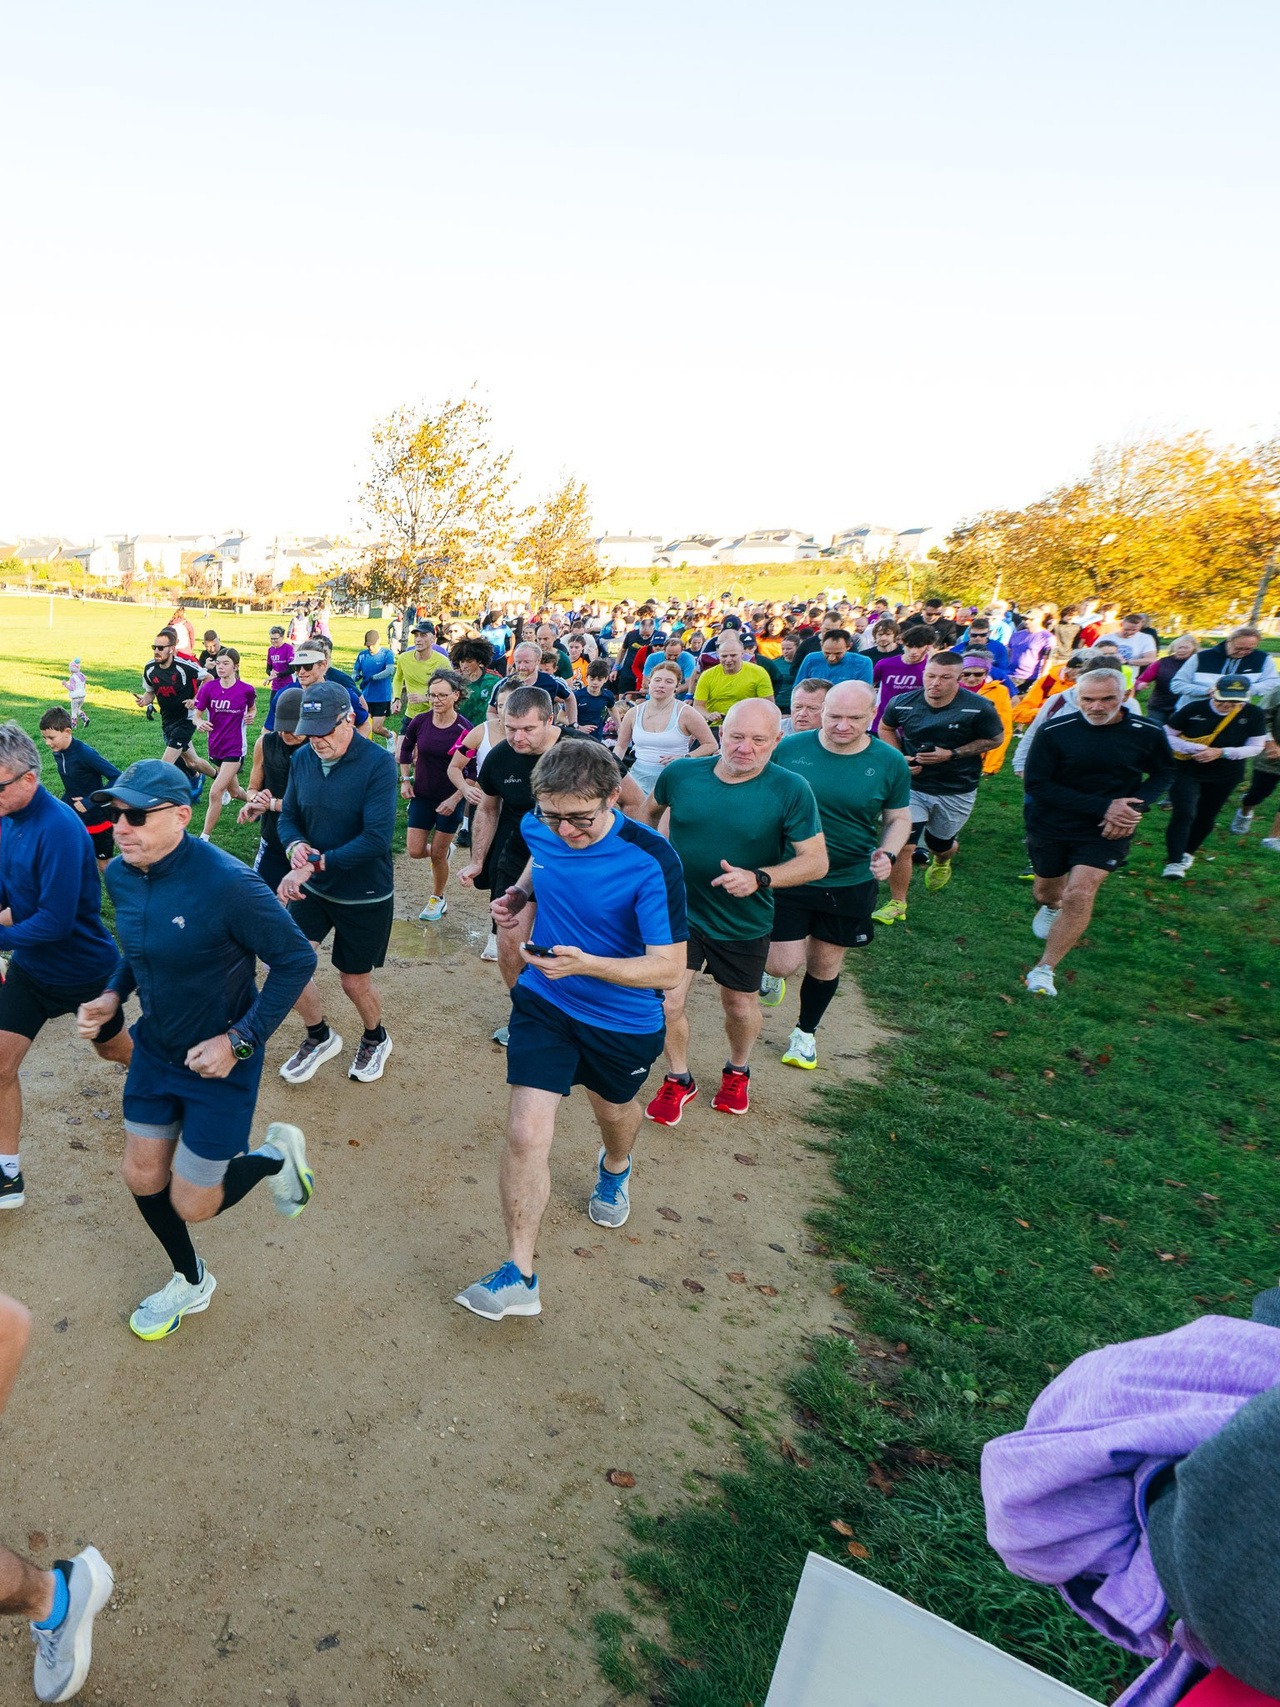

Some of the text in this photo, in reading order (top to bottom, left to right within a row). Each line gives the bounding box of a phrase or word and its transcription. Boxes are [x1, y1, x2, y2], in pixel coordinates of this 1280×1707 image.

[886, 674, 917, 685] run
[156, 686, 177, 697] AXA
[210, 699, 231, 709] run
[504, 774, 522, 784] parkrun
